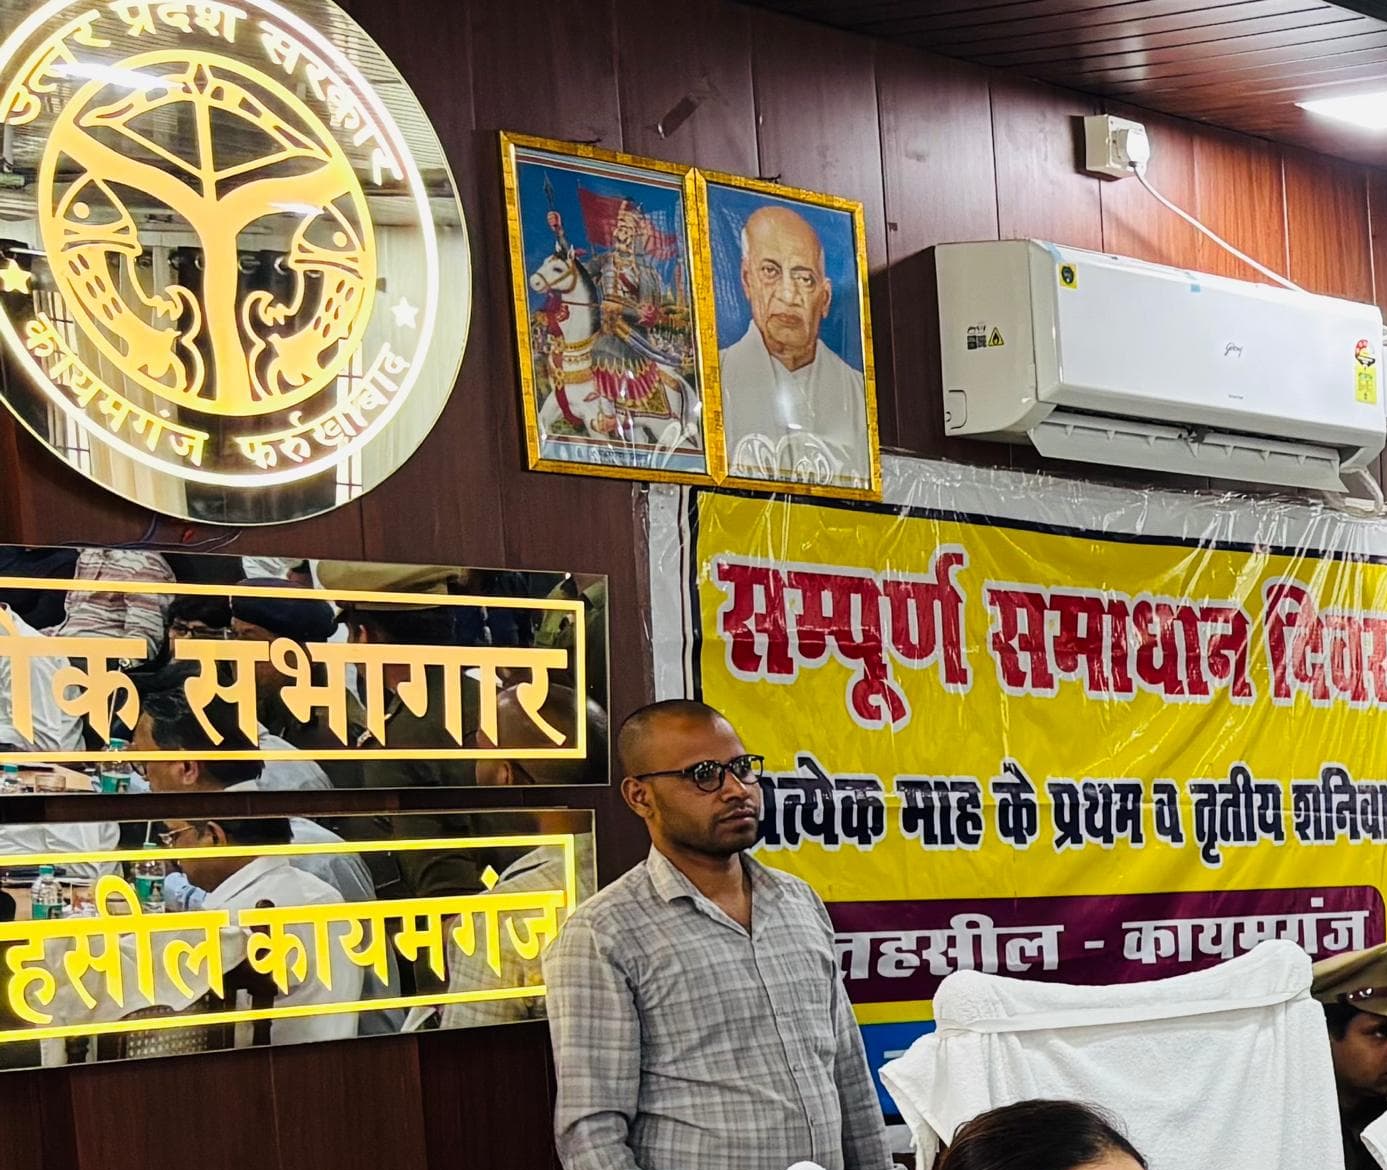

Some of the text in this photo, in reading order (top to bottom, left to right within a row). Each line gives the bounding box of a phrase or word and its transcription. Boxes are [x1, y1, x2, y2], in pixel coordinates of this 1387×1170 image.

[257, 20, 404, 187] सरकार
[25, 311, 210, 467] कायमगंज
[174, 637, 568, 746] सभागार
[716, 551, 964, 724] सम्पूर्ण
[986, 588, 1253, 697] समाधान
[896, 780, 983, 845] माह
[991, 762, 1037, 844] के
[1047, 781, 1144, 848] प्रथम
[1153, 783, 1183, 844] व
[1190, 765, 1284, 864] तृतीय
[0, 865, 567, 1024] हसील कायमगंज
[834, 913, 1064, 979] तहसील
[1122, 897, 1369, 964] कायमगंज
